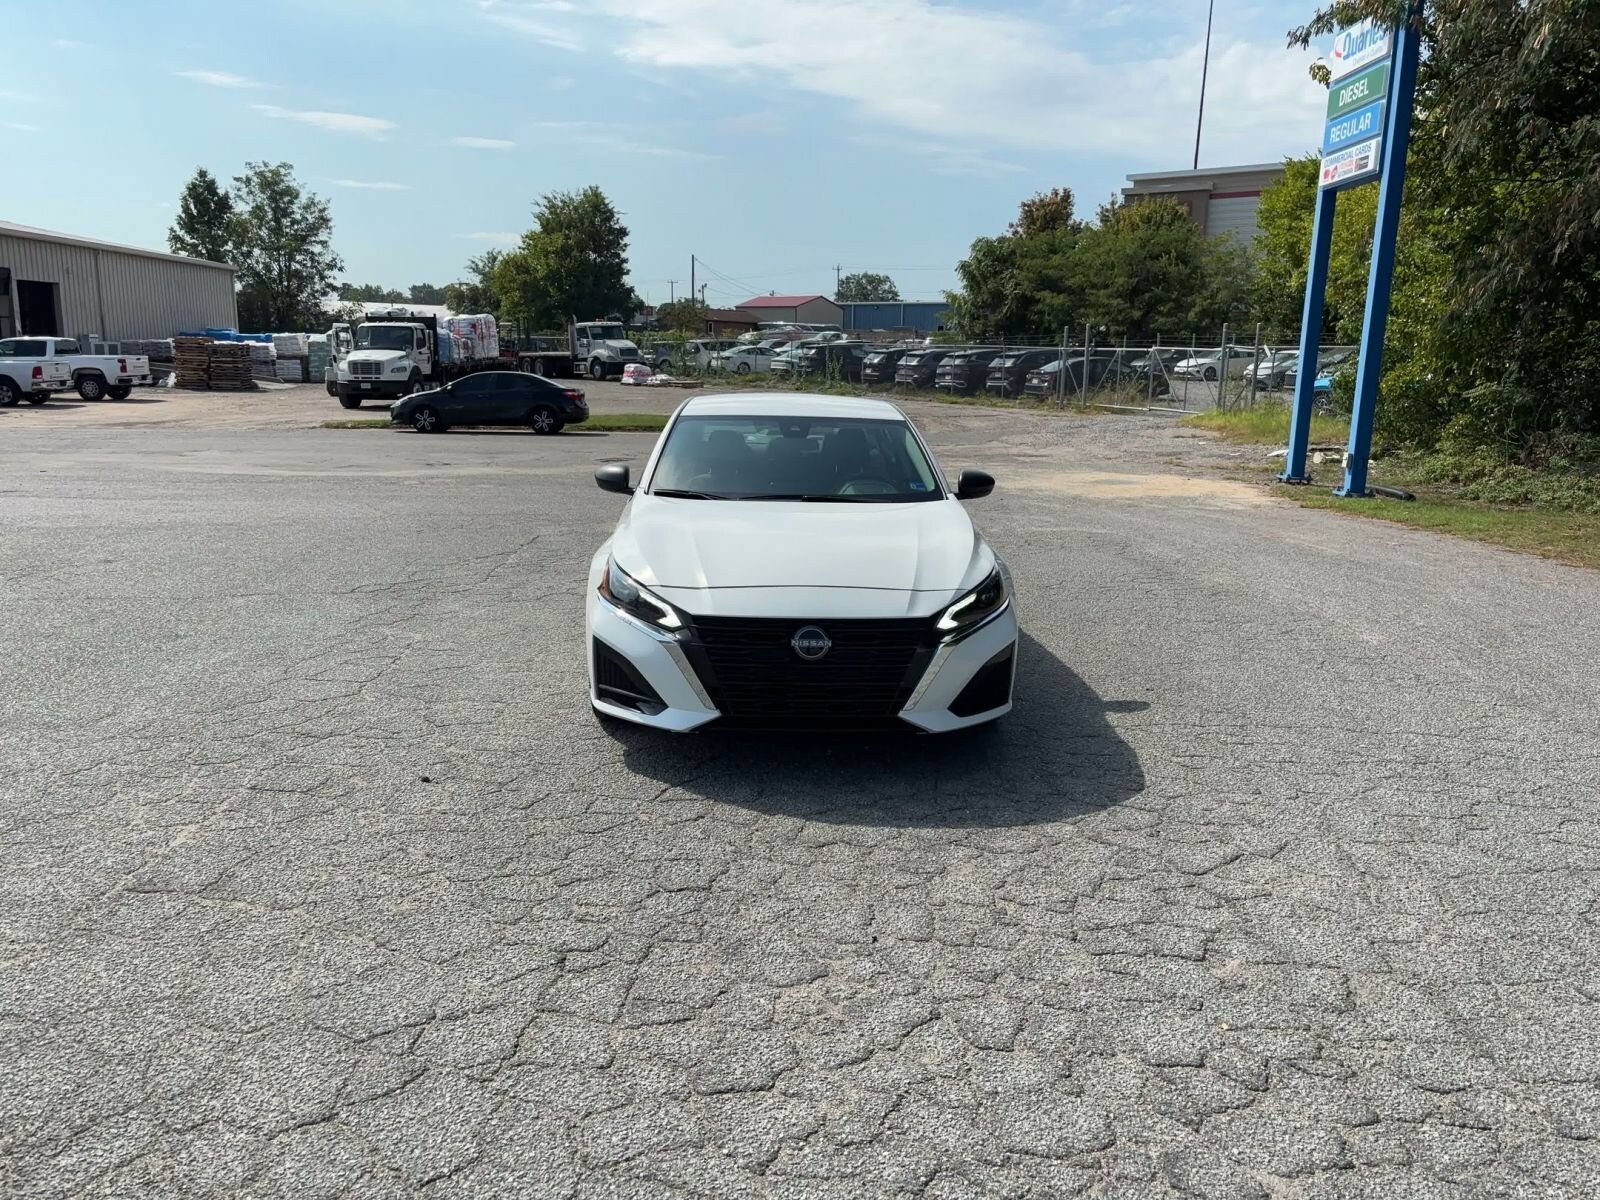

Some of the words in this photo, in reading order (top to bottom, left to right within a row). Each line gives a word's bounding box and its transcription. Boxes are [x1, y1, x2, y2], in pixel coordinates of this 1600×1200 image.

[1339, 78, 1369, 106] DIESEL
[1330, 112, 1371, 143] REGULAR
[791, 639, 832, 647] NISSAN
